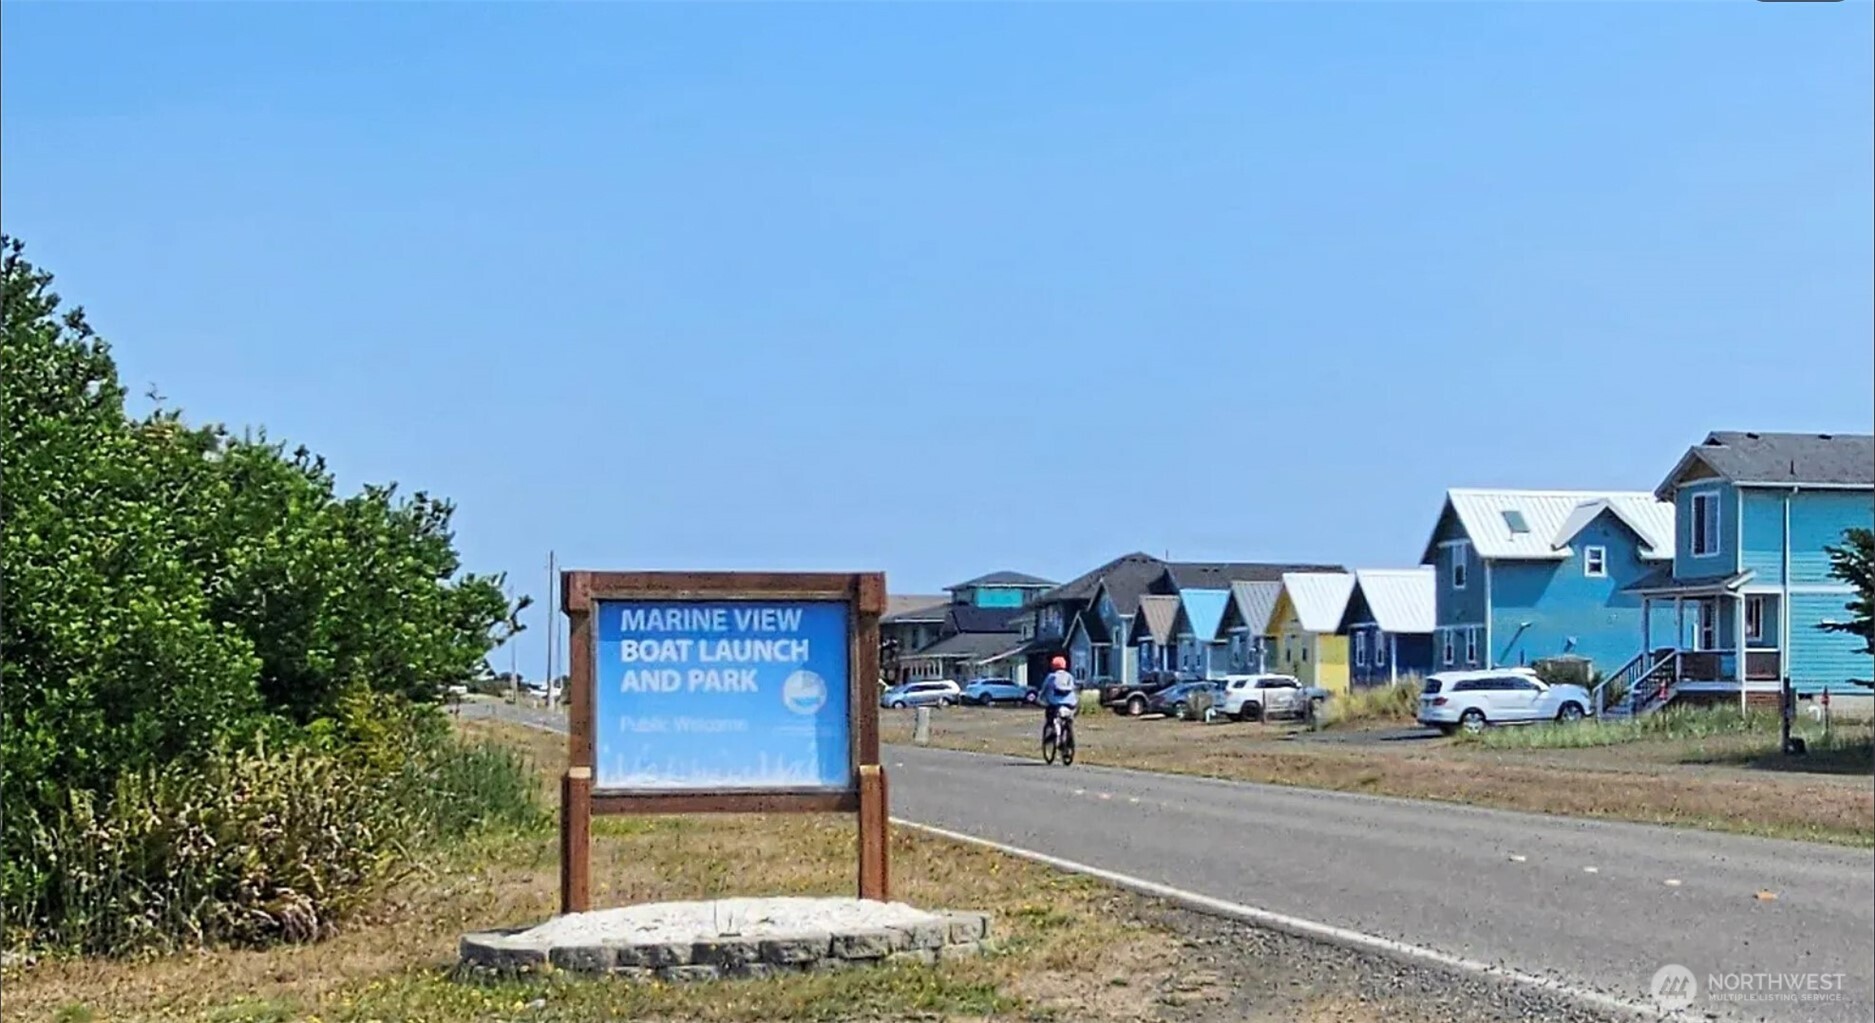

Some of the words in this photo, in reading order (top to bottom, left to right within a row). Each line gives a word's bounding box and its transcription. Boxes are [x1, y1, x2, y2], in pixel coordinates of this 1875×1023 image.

[620, 608, 727, 632] MARINE
[733, 608, 803, 632] VIEW
[620, 638, 693, 662] BOAT
[699, 638, 809, 662] LAUNCH
[620, 669, 681, 693] AND
[688, 669, 759, 693] PARK
